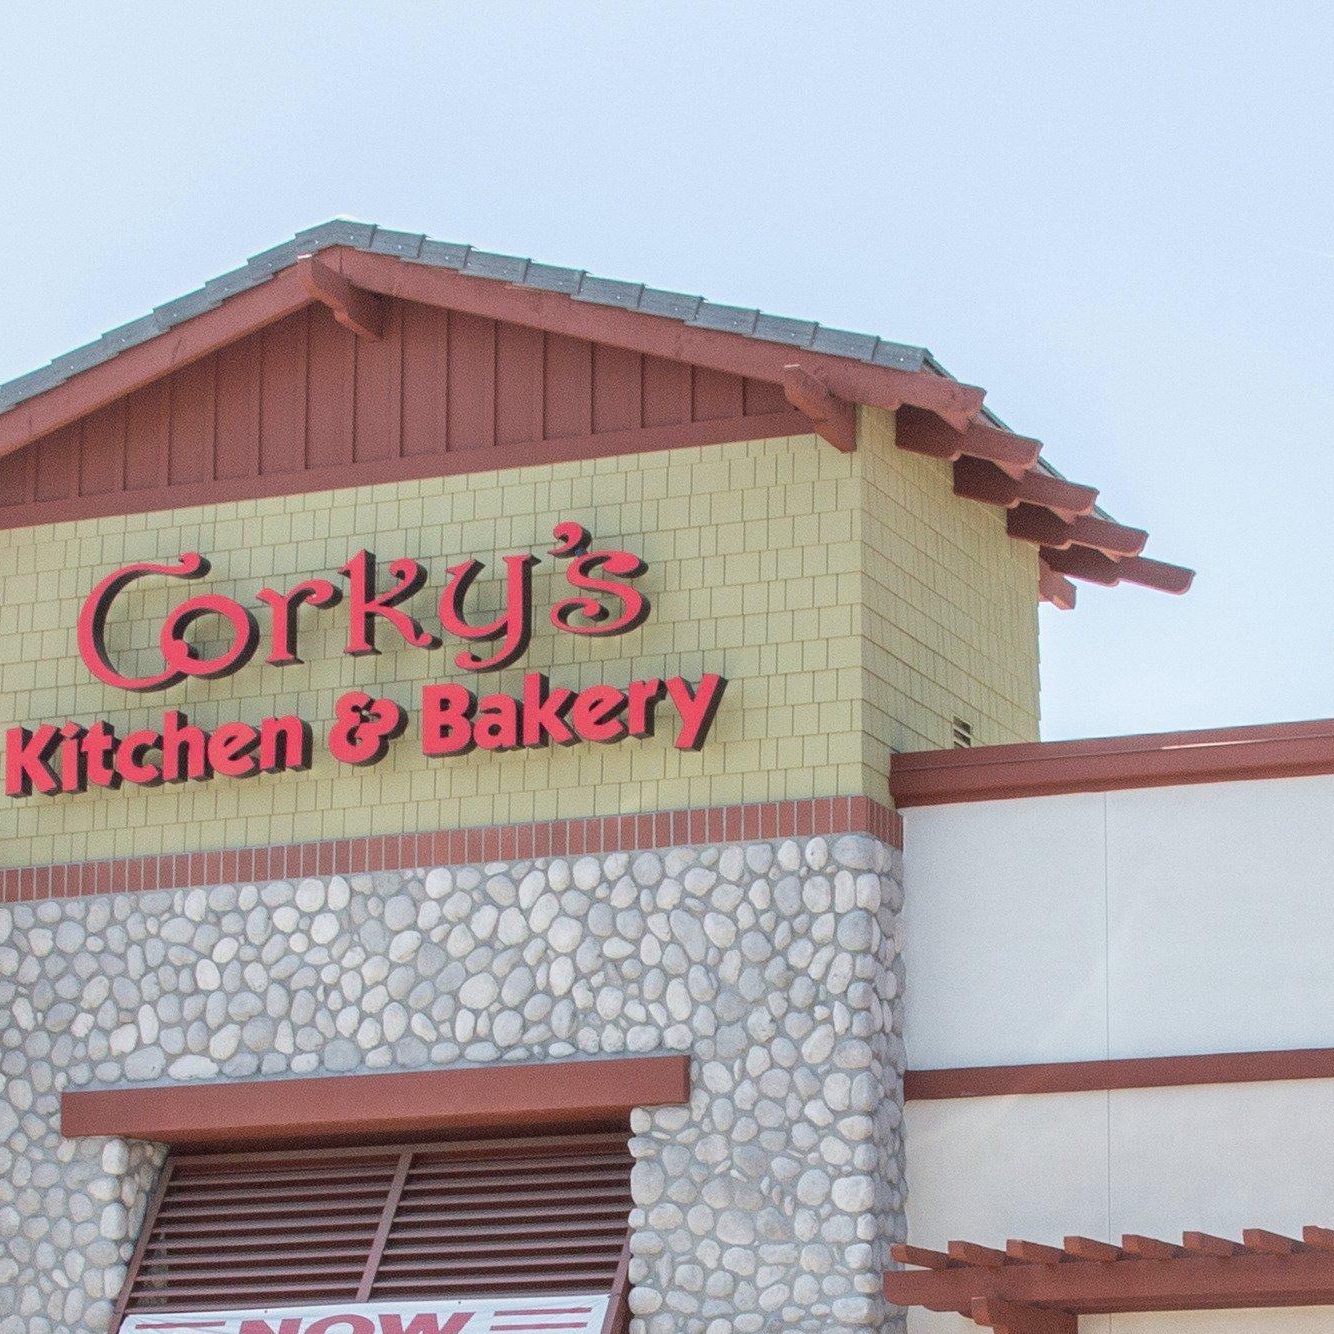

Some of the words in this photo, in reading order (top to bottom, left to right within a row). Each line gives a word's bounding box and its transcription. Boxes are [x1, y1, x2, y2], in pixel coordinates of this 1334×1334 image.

[77, 522, 650, 693] Corky's
[6, 711, 313, 797] Kitchen
[329, 691, 408, 767] &
[421, 672, 728, 758] Bakery
